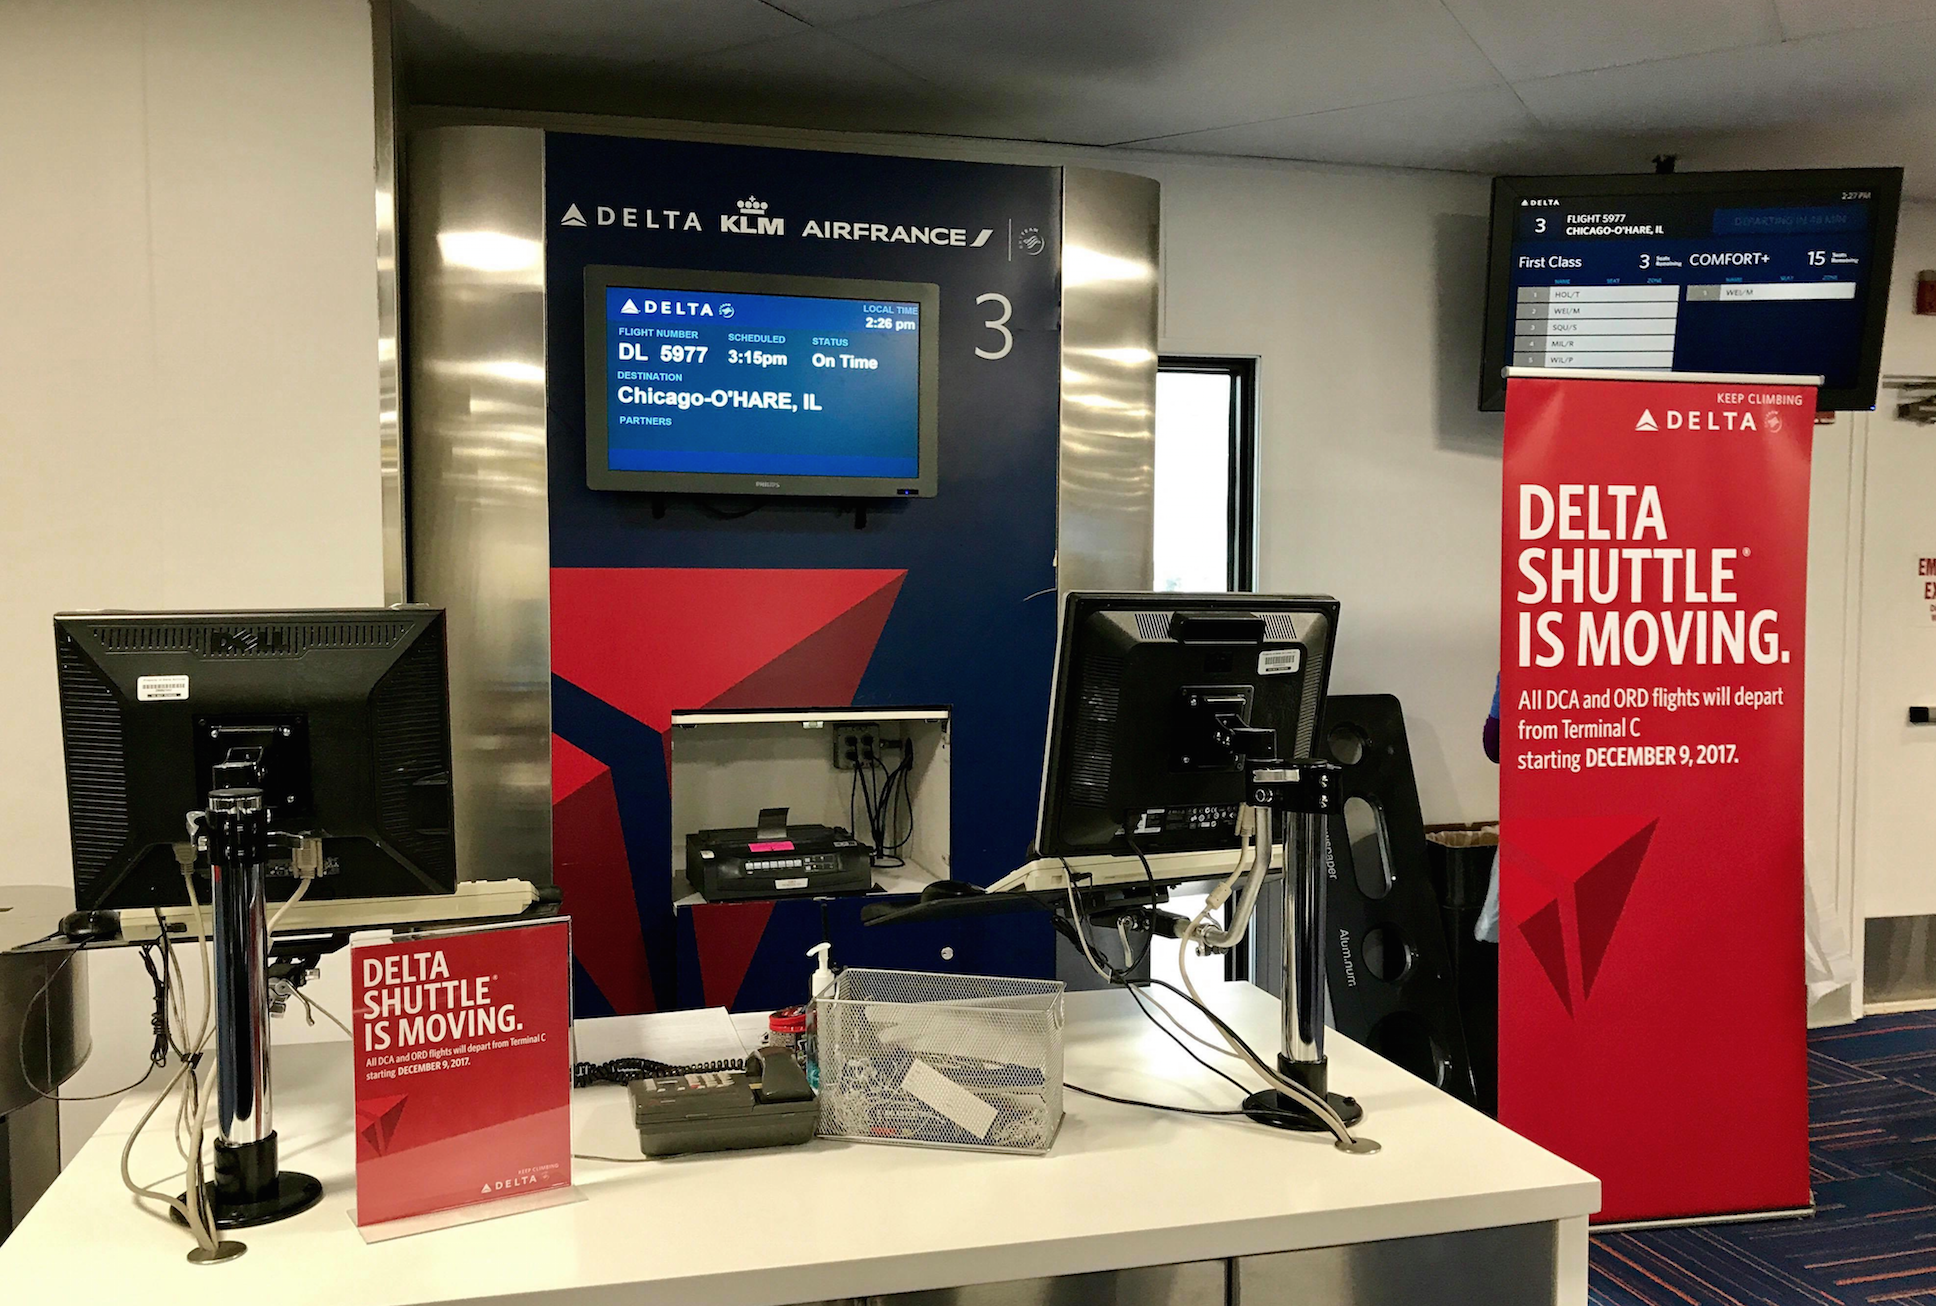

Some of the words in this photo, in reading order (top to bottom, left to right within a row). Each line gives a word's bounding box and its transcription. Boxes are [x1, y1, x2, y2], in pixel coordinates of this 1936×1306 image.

[597, 206, 702, 232] DELTA
[721, 215, 784, 236] KLM
[802, 220, 967, 247] AIRFRANCE
[1534, 218, 1547, 233] 3
[1567, 214, 1601, 223] FLIGHT
[1602, 214, 1626, 223] 5977
[1566, 225, 1654, 235] CHICAGO-O'HARE,
[1655, 226, 1664, 234] IL
[1519, 256, 1545, 268] First
[1549, 256, 1582, 268] Class
[1639, 254, 1650, 269] 3
[1689, 252, 1770, 266] COMFORT+
[1808, 251, 1826, 266] 15
[645, 300, 714, 317] DELTA
[863, 305, 894, 314] LOCAL
[897, 306, 919, 315] TIME
[865, 317, 893, 329] 2:26
[895, 320, 916, 331] pm
[975, 293, 1012, 359] 3
[618, 327, 654, 337] FLIGHT
[656, 329, 699, 339] NUMBER
[728, 333, 786, 344] SCHEDULED
[812, 337, 849, 347] STATUS
[618, 343, 648, 361] DL
[660, 345, 708, 363] 5977
[728, 350, 788, 367] 3:15pm
[812, 353, 835, 369] On
[839, 354, 878, 370] Time
[617, 371, 683, 382] DESTINATION
[617, 386, 798, 413] Chicago-O'HARE,
[803, 393, 822, 411] IL
[1717, 393, 1744, 404] KEEP
[1748, 393, 1803, 406] CLIMBING
[619, 416, 672, 426] PARTNERS
[1667, 410, 1757, 431] DELTA
[1518, 484, 1668, 541] DELTA
[211, 629, 289, 653] DELL
[1518, 611, 1565, 668] IS
[1577, 609, 1790, 668] MOVING.
[1518, 690, 1542, 710] All
[1546, 689, 1579, 710] DCA
[1583, 688, 1610, 709] and
[1613, 688, 1649, 709] ORD
[1652, 687, 1700, 712] flights
[1703, 686, 1731, 707] will
[1734, 686, 1784, 712] depart
[1518, 719, 1558, 740] from
[1562, 717, 1626, 739] Terminal
[1629, 717, 1641, 738] C
[1517, 749, 1581, 773] starting
[1586, 746, 1676, 768] DECEMBER
[1679, 746, 1693, 768] 9,
[1696, 744, 1739, 765] 2017.
[363, 951, 450, 988] DELTA
[364, 1020, 391, 1051] IS
[398, 1004, 523, 1047] MOVING.
[366, 1057, 378, 1068] All
[378, 1055, 395, 1067] DCA
[396, 1053, 410, 1064] and
[411, 1051, 428, 1062] ORD
[429, 1048, 452, 1061] flights
[453, 1045, 466, 1056] will
[467, 1042, 491, 1055] depart
[492, 1039, 509, 1049] from
[510, 1034, 539, 1047] Terminal
[540, 1033, 546, 1043] C
[366, 1068, 396, 1082] starting
[398, 1061, 441, 1077] DECEMBER
[442, 1060, 450, 1071] 9,
[450, 1057, 470, 1069] 2017.
[533, 1163, 559, 1173] CLIMBING
[495, 1174, 537, 1190] DELTA
